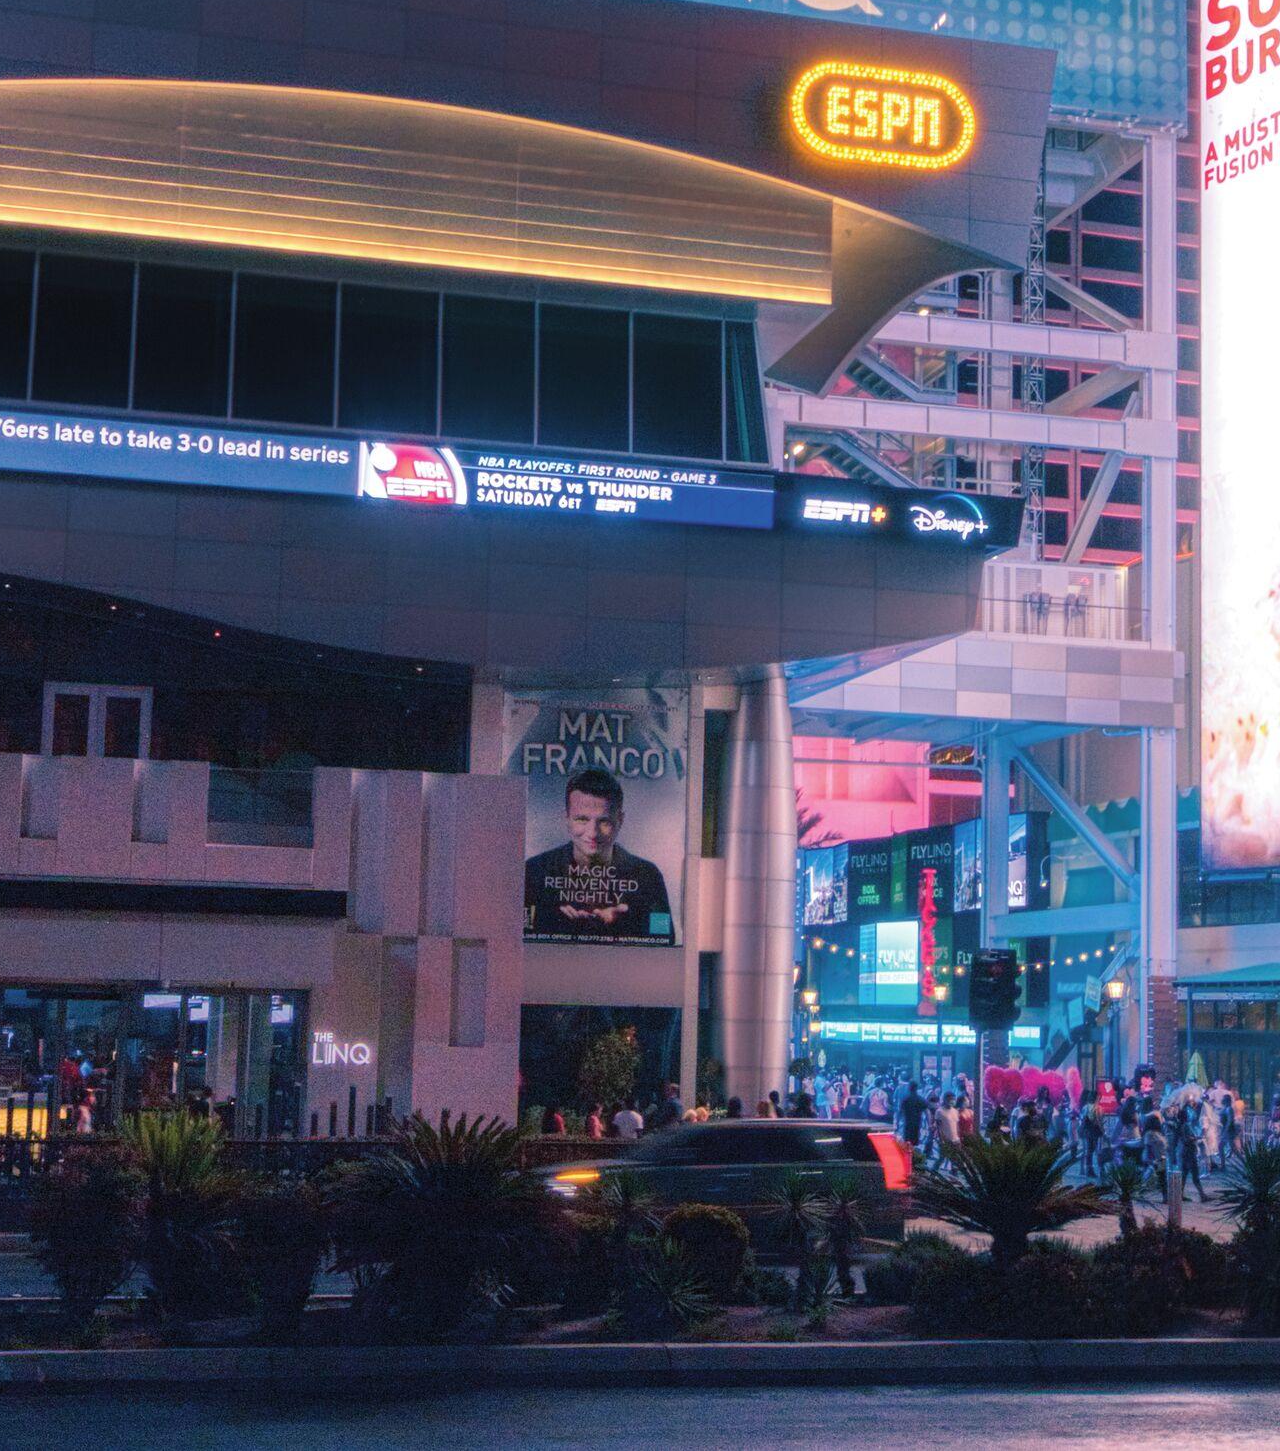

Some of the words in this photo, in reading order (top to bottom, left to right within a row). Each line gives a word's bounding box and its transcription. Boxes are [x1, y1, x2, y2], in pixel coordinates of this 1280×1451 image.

[826, 85, 941, 147] ESPN
[1204, 141, 1219, 166] A
[1204, 144, 1275, 191] FUSION
[54, 421, 96, 444] late
[99, 427, 123, 446] to
[126, 427, 173, 451] take
[176, 433, 213, 454] 3-0
[218, 436, 261, 459] lead
[266, 440, 285, 460] in
[289, 444, 350, 466] series
[413, 460, 449, 480] NBA
[478, 456, 505, 468] NBA
[508, 458, 575, 474] PLAYOFFS:
[578, 465, 614, 477] FIRST
[615, 467, 661, 481] ROUND
[671, 472, 703, 484] GAME
[708, 475, 718, 486] 3
[386, 476, 454, 498] ESPN
[477, 471, 562, 493] ROCKETS
[566, 482, 584, 494] vs
[587, 480, 673, 501] THUNDER
[476, 488, 554, 507] SATURDAY
[595, 498, 637, 514] ESPN
[559, 711, 632, 744] MAT
[523, 742, 665, 779] FRANCO
[568, 864, 617, 878] MAGIC
[544, 876, 639, 892] REINVENTED
[862, 884, 876, 894] BOX
[559, 890, 624, 904] NIGHTLY
[857, 894, 880, 906] OFFICE
[313, 1032, 334, 1043] THE
[312, 1043, 371, 1065] LINQ
